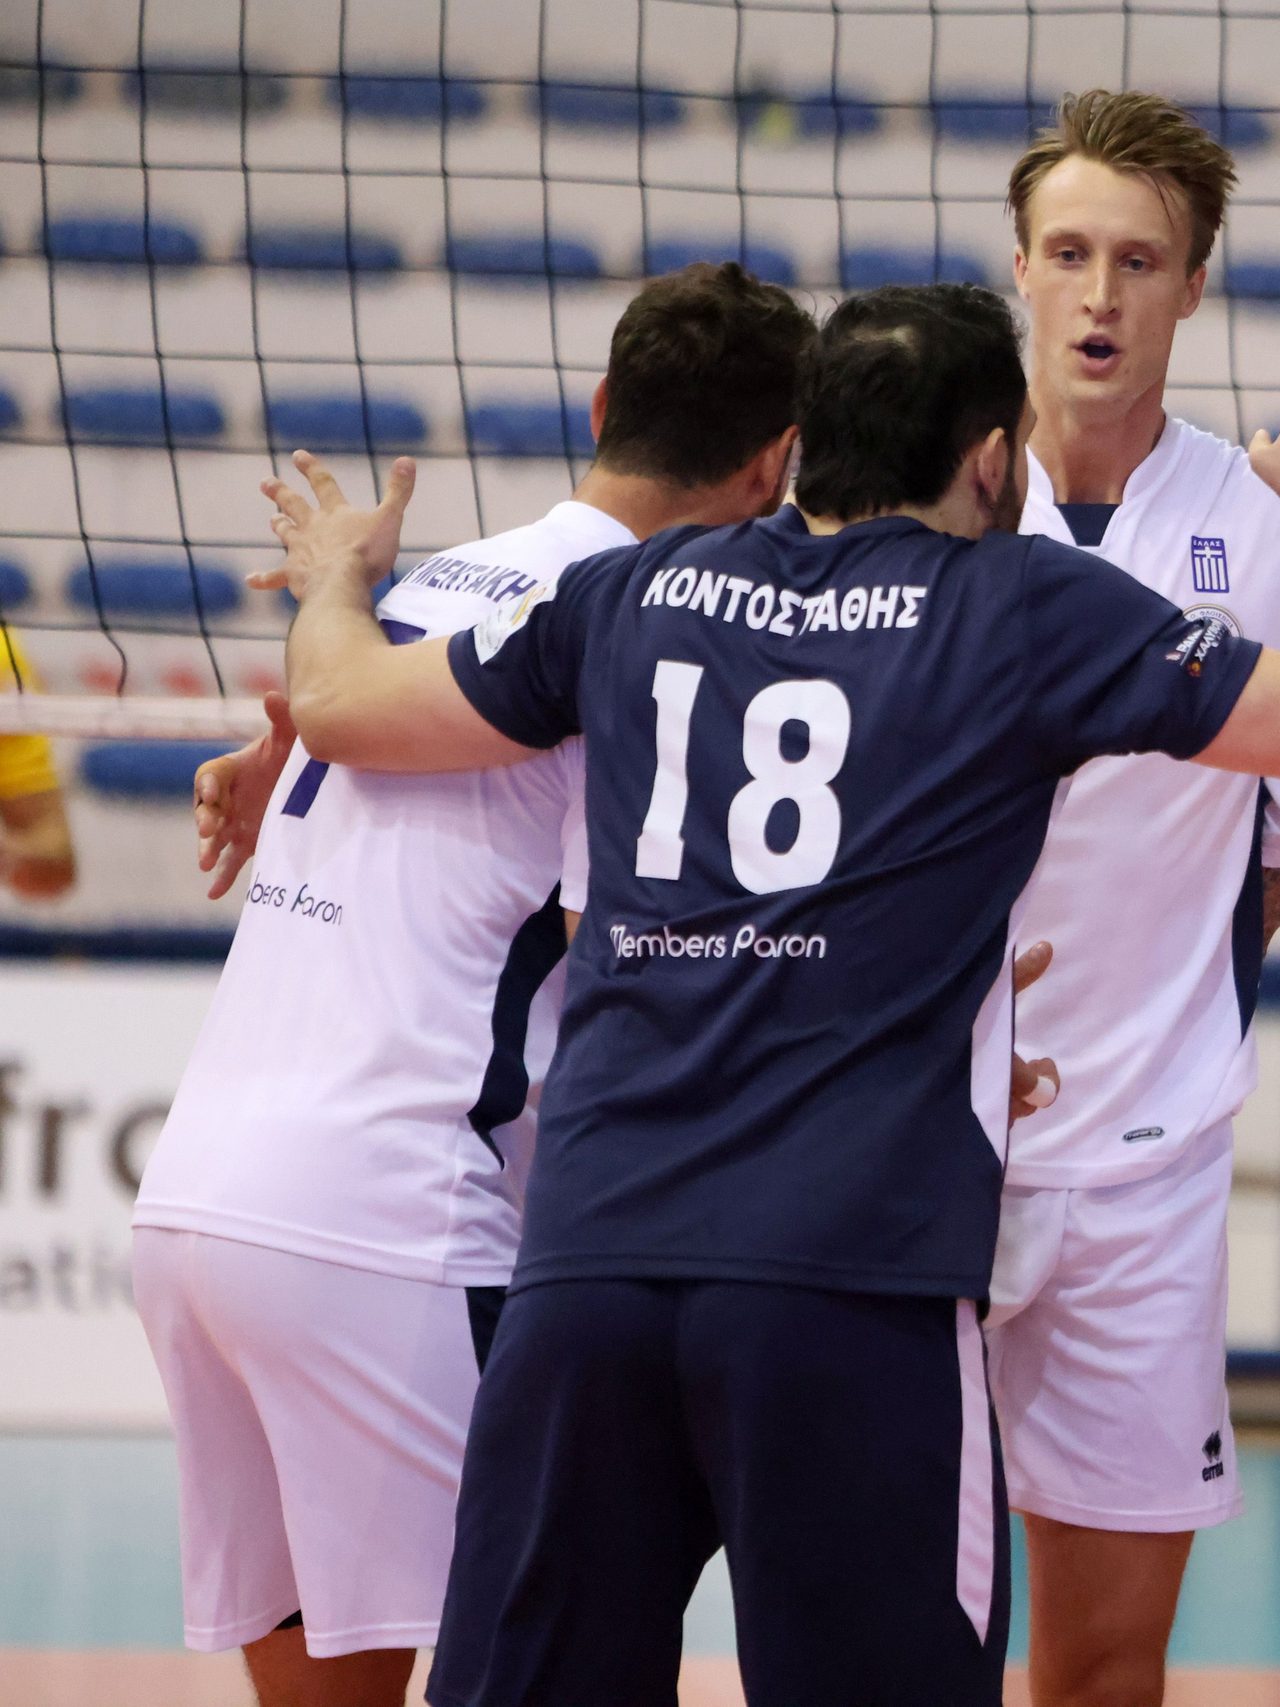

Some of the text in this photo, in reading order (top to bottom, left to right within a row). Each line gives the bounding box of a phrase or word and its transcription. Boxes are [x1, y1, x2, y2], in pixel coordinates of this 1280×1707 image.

[641, 567, 927, 637] ΚΟΝΤΟΣΤΑΘΗΣ
[635, 660, 852, 895] 18
[610, 923, 827, 959] Members Paron
